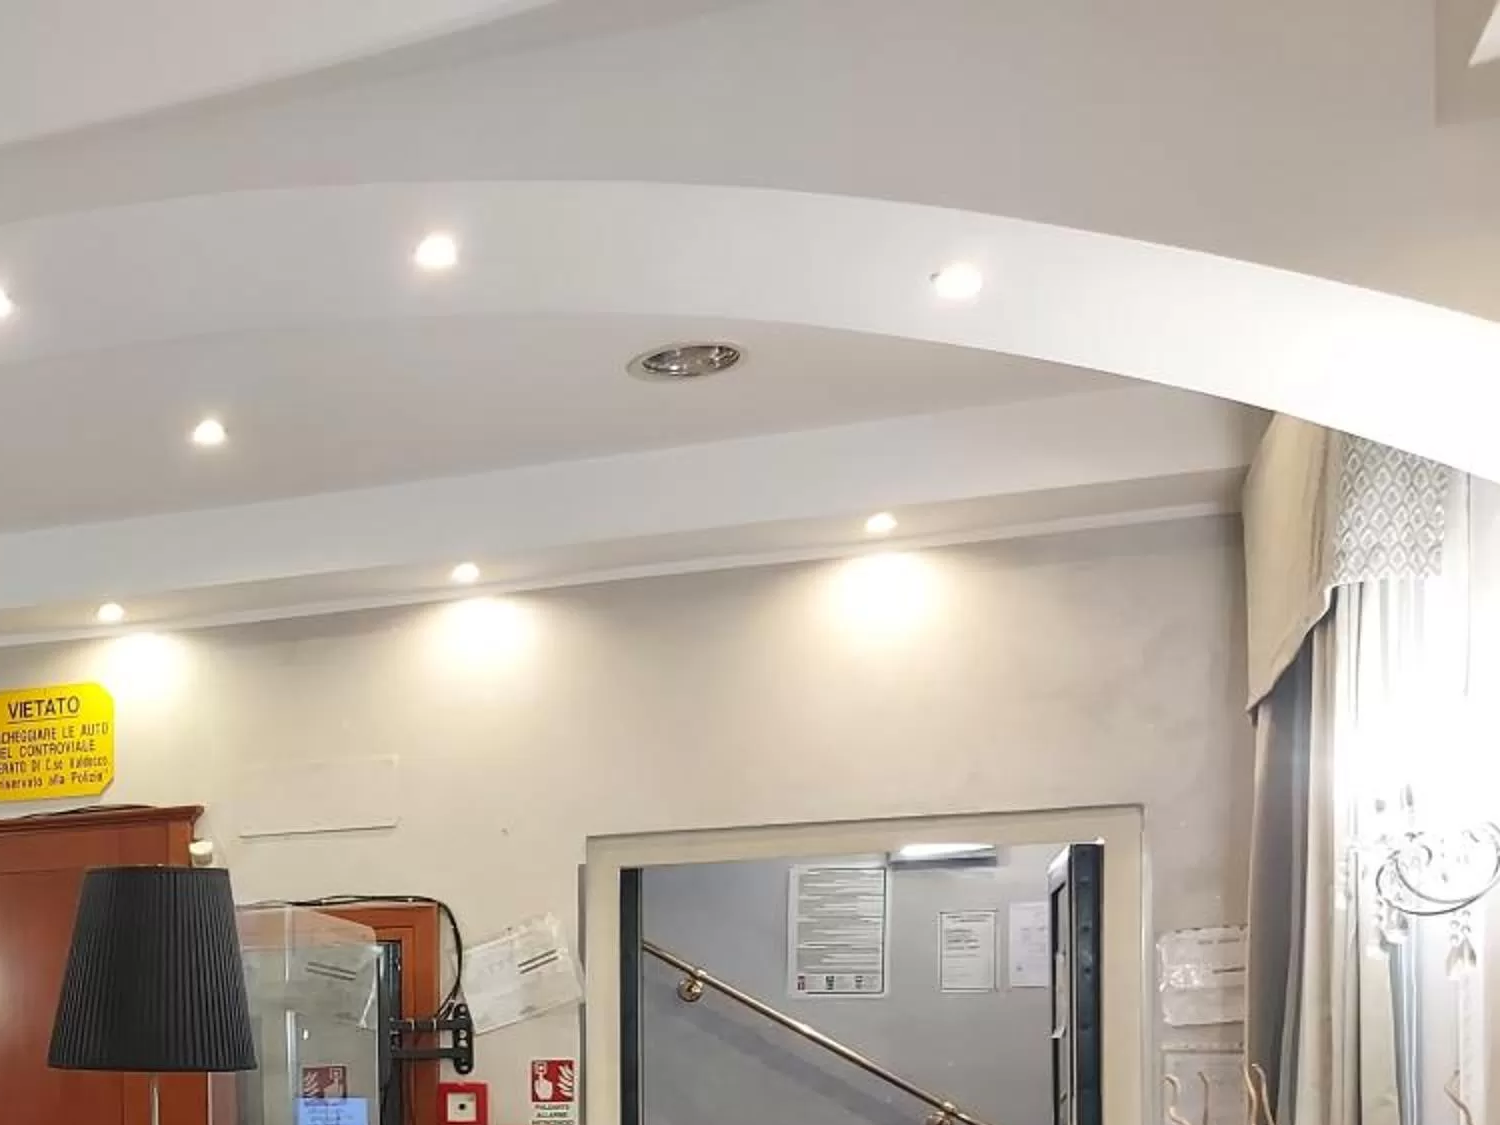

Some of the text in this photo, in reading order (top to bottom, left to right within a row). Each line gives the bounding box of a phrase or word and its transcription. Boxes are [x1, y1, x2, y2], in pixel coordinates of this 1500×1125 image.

[7, 695, 80, 719] VIETATO
[62, 725, 75, 739] LE
[81, 722, 108, 736] AUTO
[19, 739, 95, 758] CONTROVIALE
